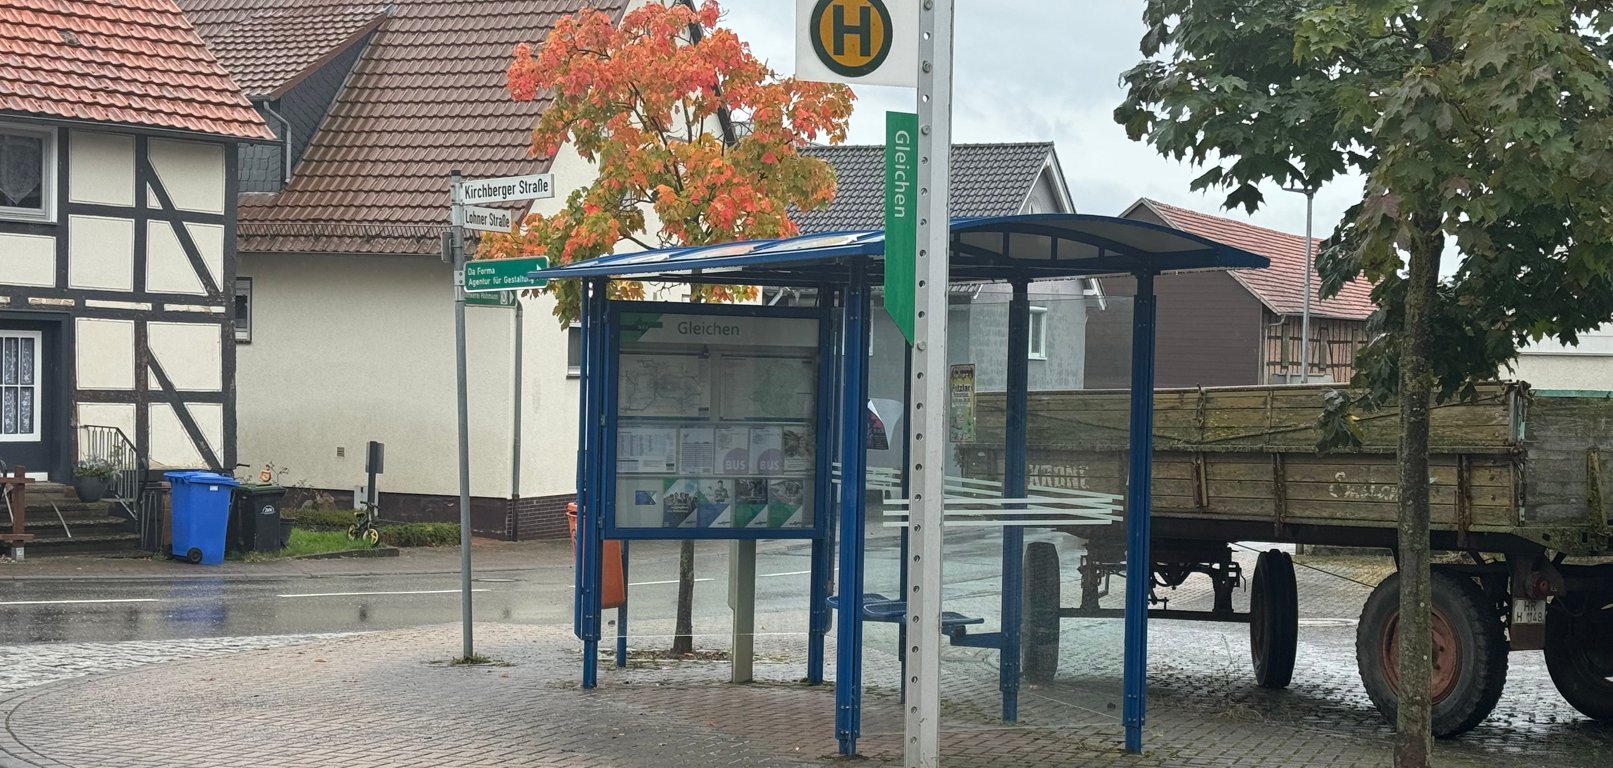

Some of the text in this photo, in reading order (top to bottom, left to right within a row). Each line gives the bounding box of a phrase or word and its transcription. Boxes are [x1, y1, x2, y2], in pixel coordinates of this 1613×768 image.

[832, 4, 871, 57] H
[895, 130, 910, 218] Gleichen
[465, 178, 548, 200] Kirchberger Straße
[465, 209, 510, 228] Lohner Straße
[467, 267, 496, 276] Da Forma
[468, 278, 491, 288] Agentur
[504, 276, 534, 285] Gestaltug
[677, 321, 740, 336] Gleichen
[725, 459, 746, 471] BUS
[759, 459, 780, 471] BUS
[1523, 600, 1537, 612] HR
